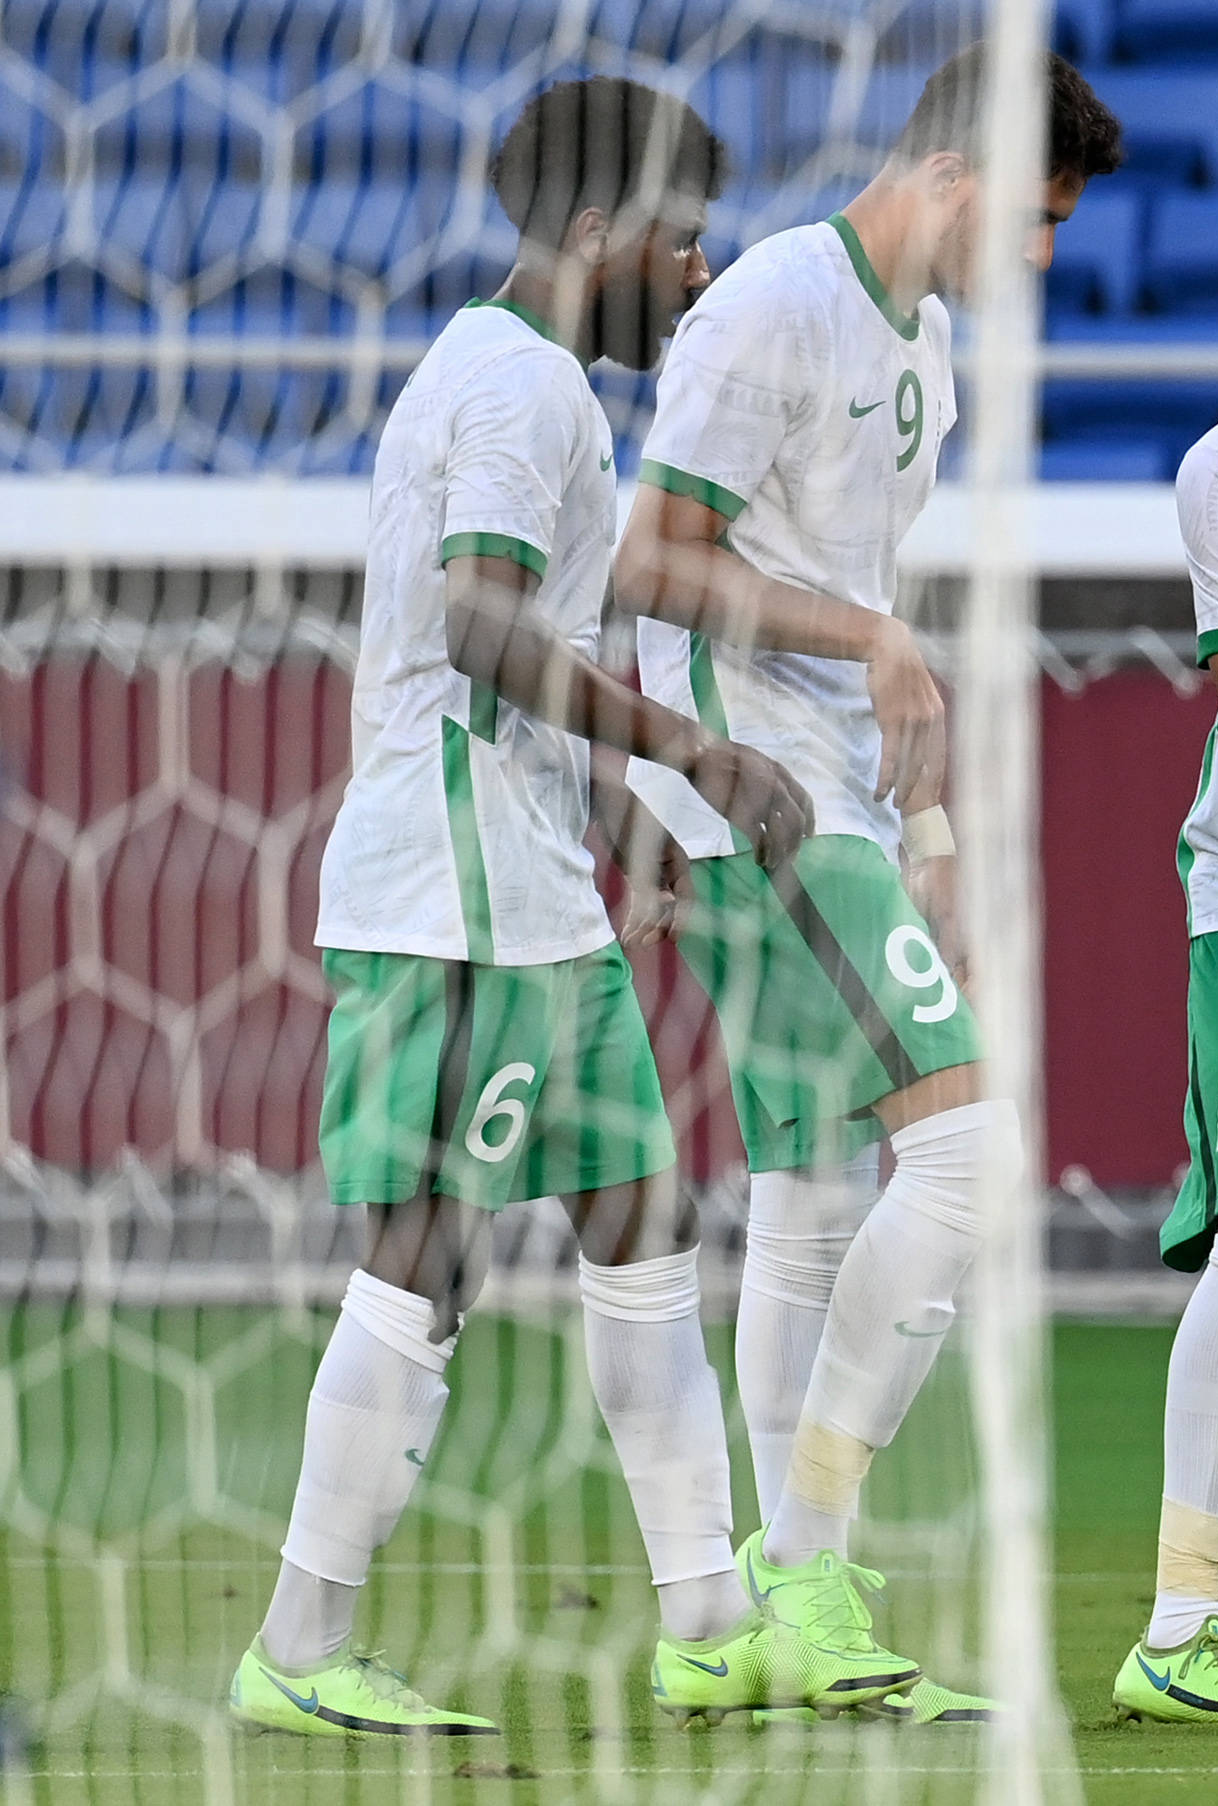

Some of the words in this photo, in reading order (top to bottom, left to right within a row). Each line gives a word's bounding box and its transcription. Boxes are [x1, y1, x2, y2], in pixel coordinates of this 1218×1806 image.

[896, 369, 923, 472] 9
[885, 925, 957, 1022] 9
[465, 1062, 535, 1162] 6
